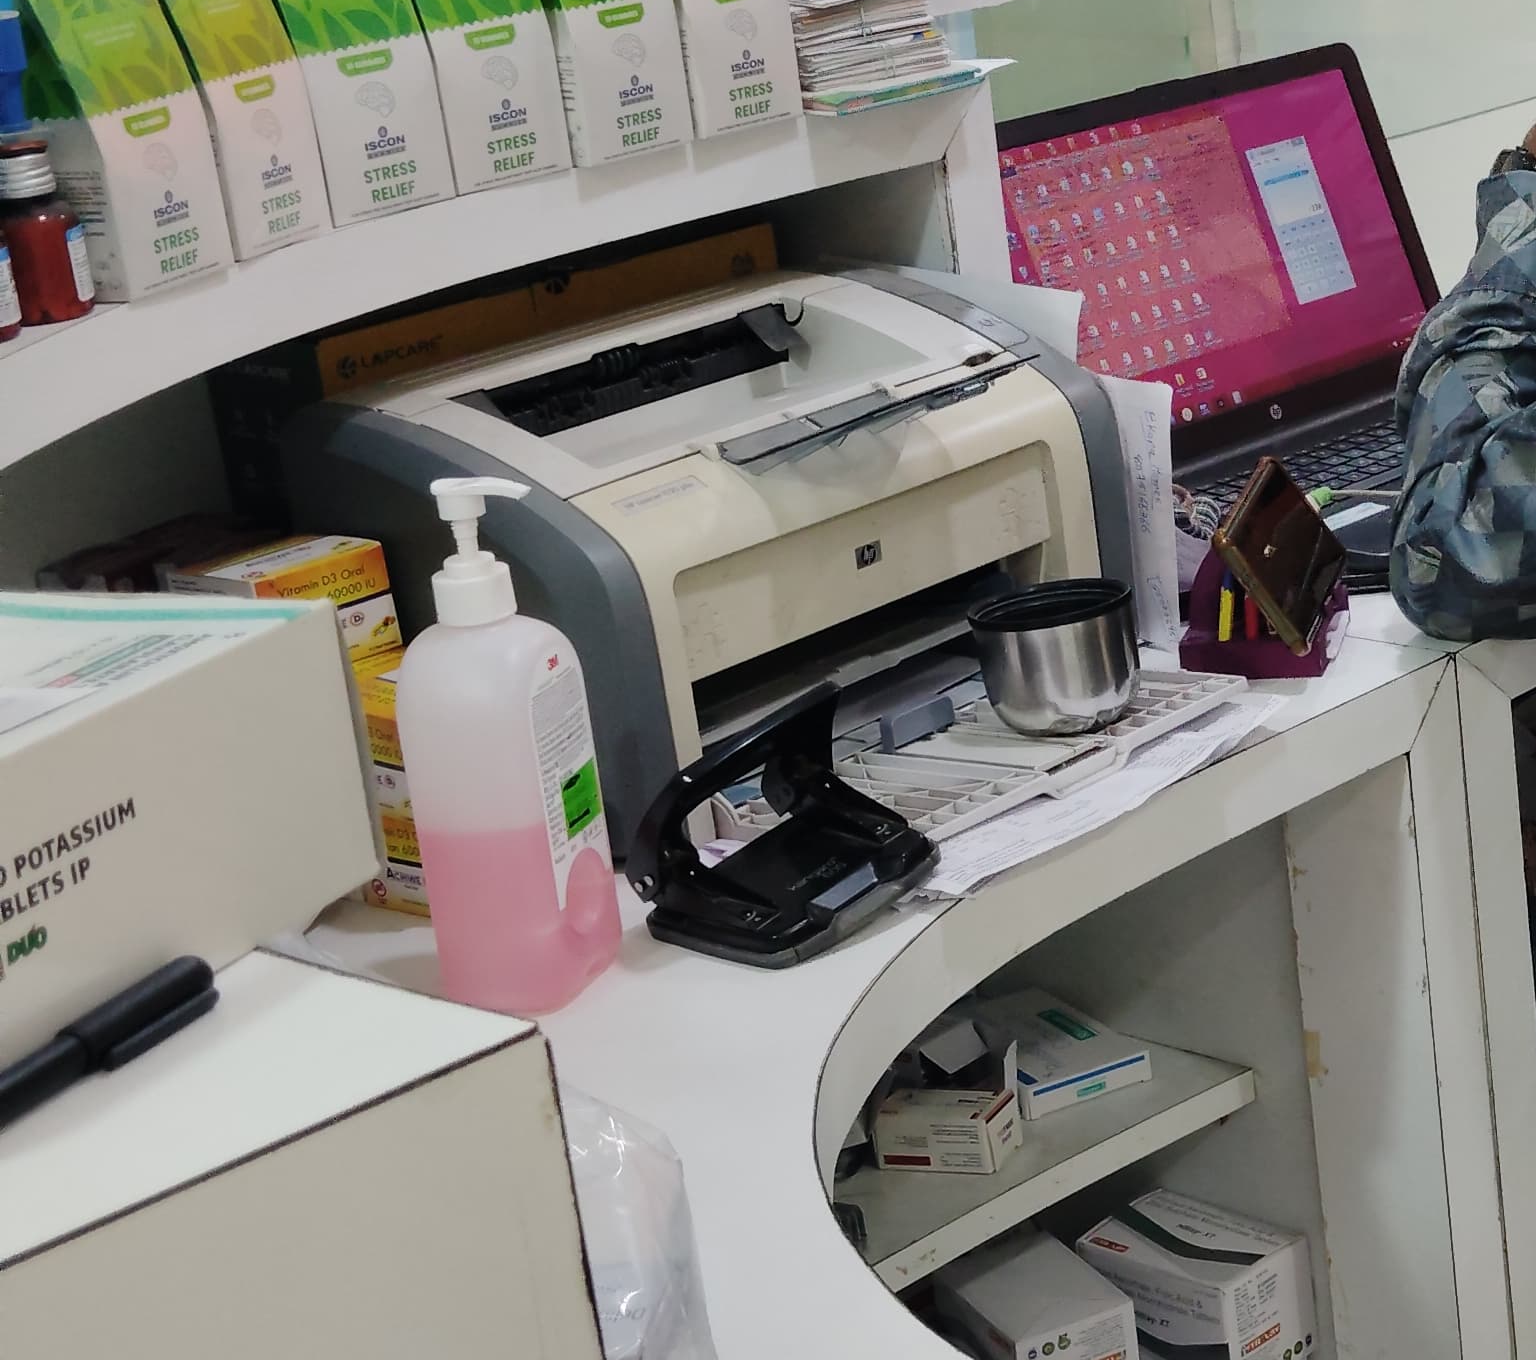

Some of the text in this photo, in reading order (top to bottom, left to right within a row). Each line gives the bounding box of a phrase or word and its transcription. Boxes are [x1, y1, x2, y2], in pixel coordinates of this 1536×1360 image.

[731, 58, 765, 73] ISCON
[619, 84, 653, 100] ISCON
[729, 81, 773, 102] STRESS
[489, 108, 527, 124] ISCON
[616, 108, 662, 129] STRESS
[734, 100, 771, 119] RELIEF
[364, 135, 405, 152] ISCON
[487, 132, 536, 154] STRESS
[622, 127, 660, 147] RELIEF
[261, 164, 292, 181] ISCON
[364, 160, 417, 184] STRESS
[494, 152, 535, 173] RELIEF
[261, 190, 301, 215] STRESS
[372, 181, 415, 204] RELIEF
[153, 200, 189, 220] ISCON
[268, 211, 301, 235] RELIEF
[153, 227, 199, 254] STRESS
[160, 249, 199, 274] RELIEF
[277, 566, 366, 598] Vitamin D3 Oral
[365, 579, 377, 589] IU
[14, 797, 136, 879] POTASSIUM
[0, 871, 64, 925] BLETS
[70, 856, 91, 884] IP
